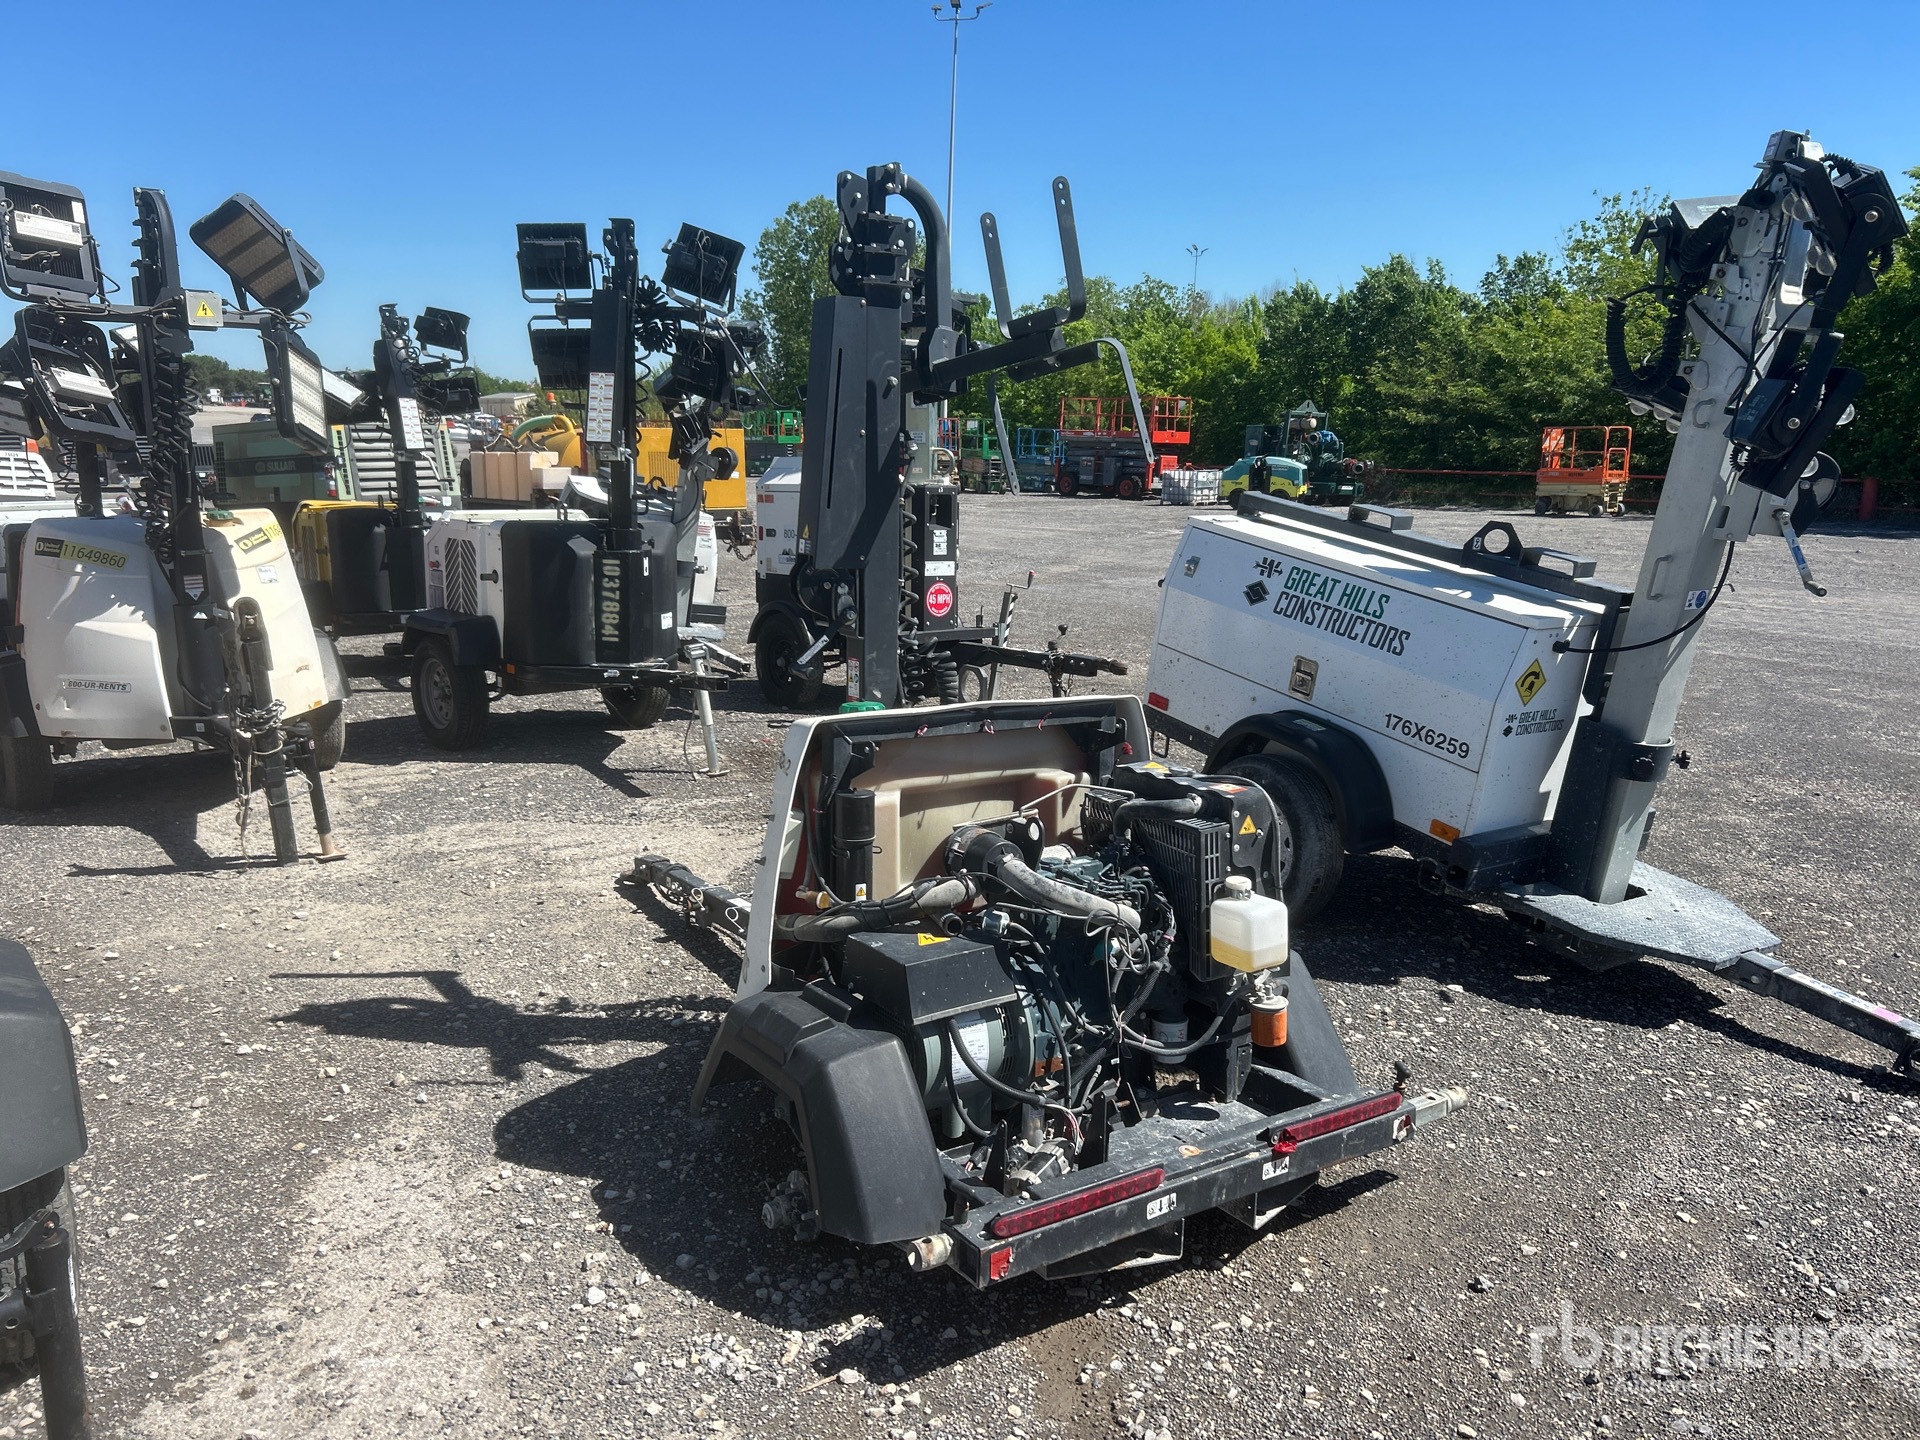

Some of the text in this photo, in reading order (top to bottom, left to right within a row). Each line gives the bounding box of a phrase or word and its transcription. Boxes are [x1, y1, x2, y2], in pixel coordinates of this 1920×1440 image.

[267, 461, 296, 472] SULLAIR
[63, 544, 126, 568] 11649860
[602, 559, 620, 641] 10378841
[929, 593, 951, 605] 45 MPH
[1284, 566, 1390, 620] GREAT HILLS
[1273, 591, 1411, 657] CONSTRUCTORS
[67, 680, 127, 691] 800-UR-RENTS
[1519, 708, 1557, 724] GREAT HILLS
[1385, 713, 1470, 759] 176X6259
[1515, 719, 1565, 736] CONSTRUCTORS
